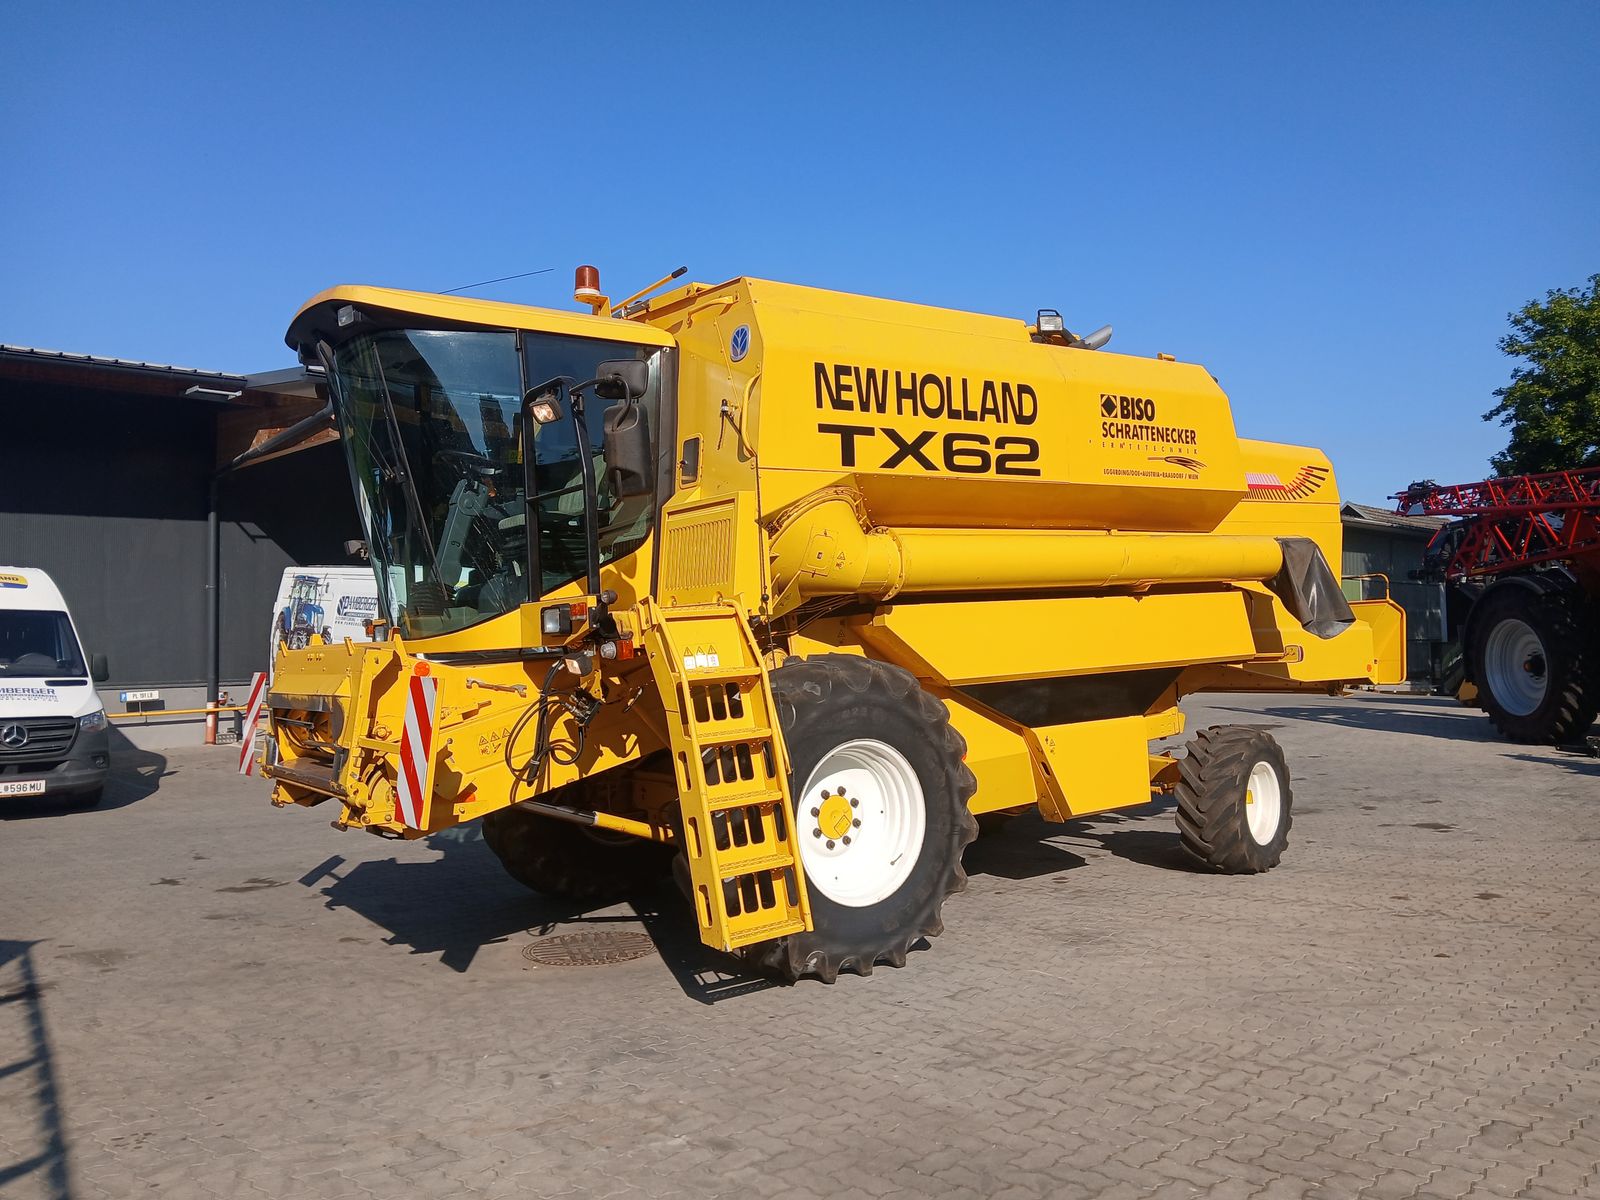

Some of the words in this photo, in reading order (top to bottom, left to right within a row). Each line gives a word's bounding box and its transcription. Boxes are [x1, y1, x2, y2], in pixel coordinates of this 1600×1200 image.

[814, 362, 889, 414] NEW
[895, 370, 1038, 425] HOLLAND
[1119, 396, 1156, 421] BISO
[1102, 421, 1197, 445] SCHRATTENECKER
[817, 423, 1041, 477] TX62
[10, 783, 28, 793] 596
[29, 782, 42, 792] MU
